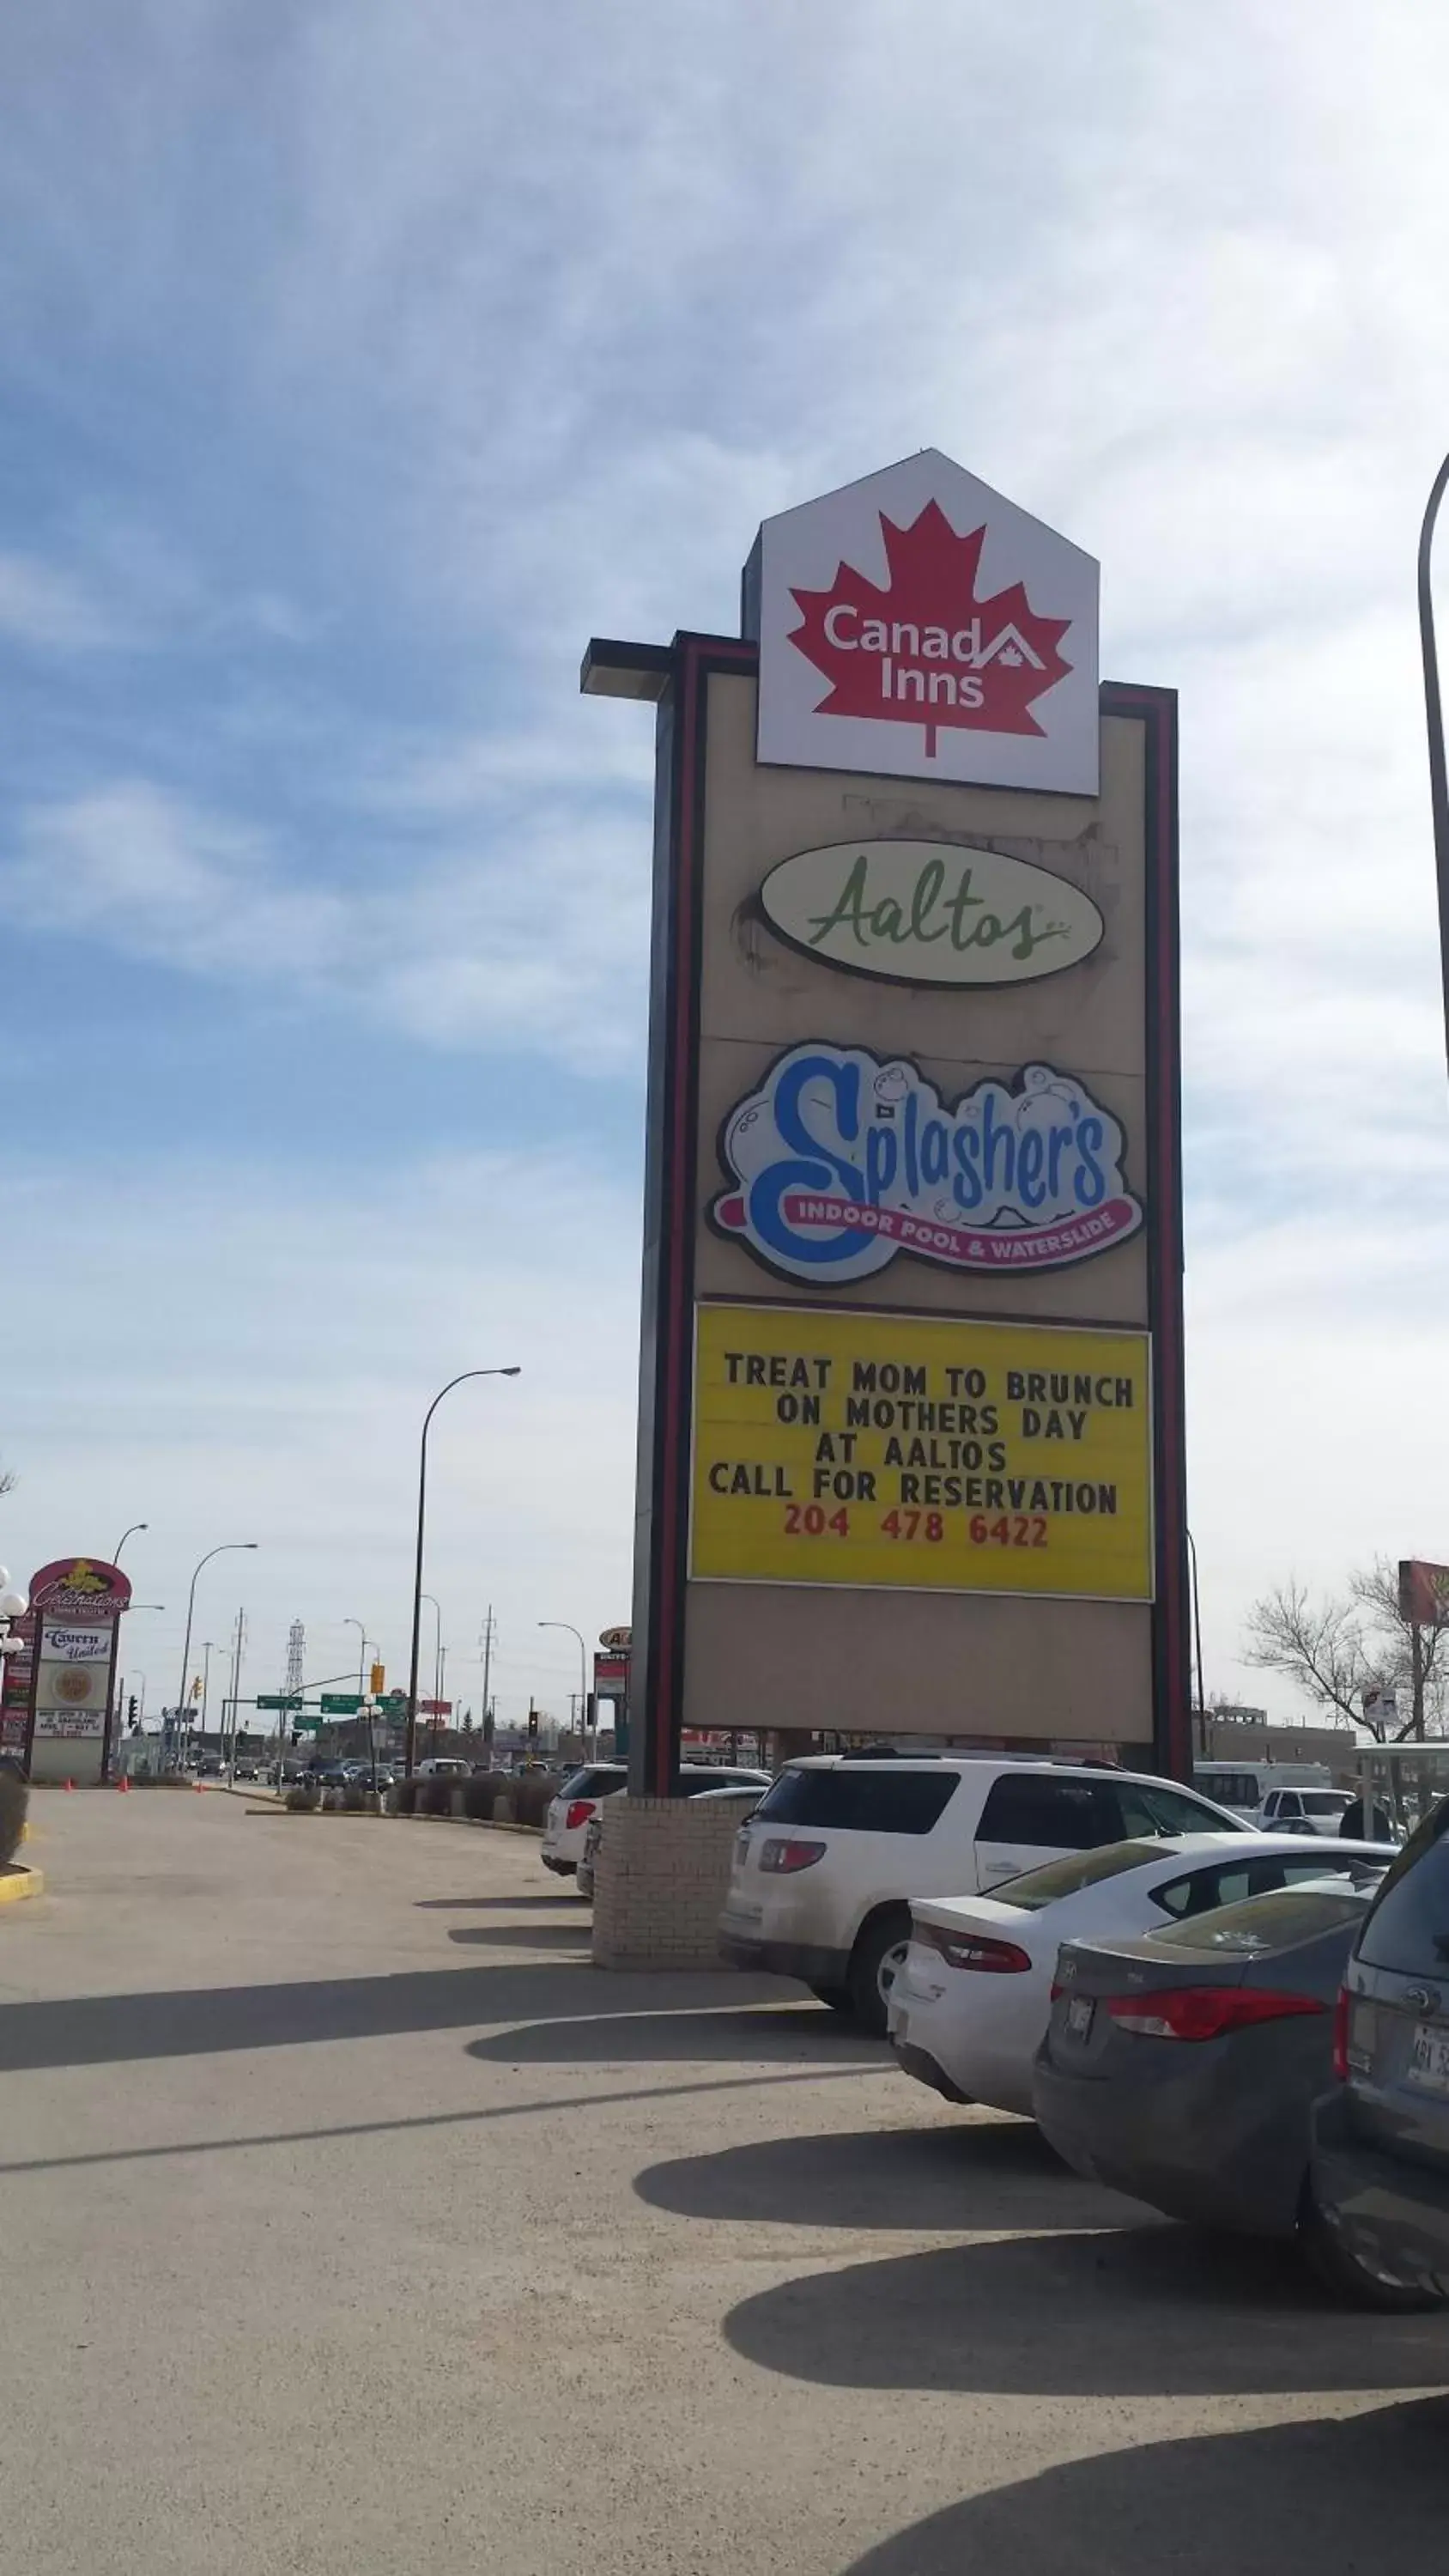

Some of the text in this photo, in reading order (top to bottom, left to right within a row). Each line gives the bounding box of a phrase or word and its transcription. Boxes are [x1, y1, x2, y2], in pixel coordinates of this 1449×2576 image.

[882, 657, 985, 708] Inns
[807, 855, 1072, 960] Aaltos
[749, 1055, 1106, 1262] Splasher's
[798, 1200, 1116, 1259] INDOOR POOL & WATERSLIDE
[724, 1352, 1133, 1407] TREAT MOM TO BRUNCH
[777, 1394, 1088, 1440] ON MOTHERS DAY
[815, 1432, 1006, 1471] AT AALTOS
[709, 1463, 1117, 1514] CALL FOR RESERVATION
[784, 1504, 1047, 1547] 204 478 6422
[45, 1629, 99, 1649] Tavern
